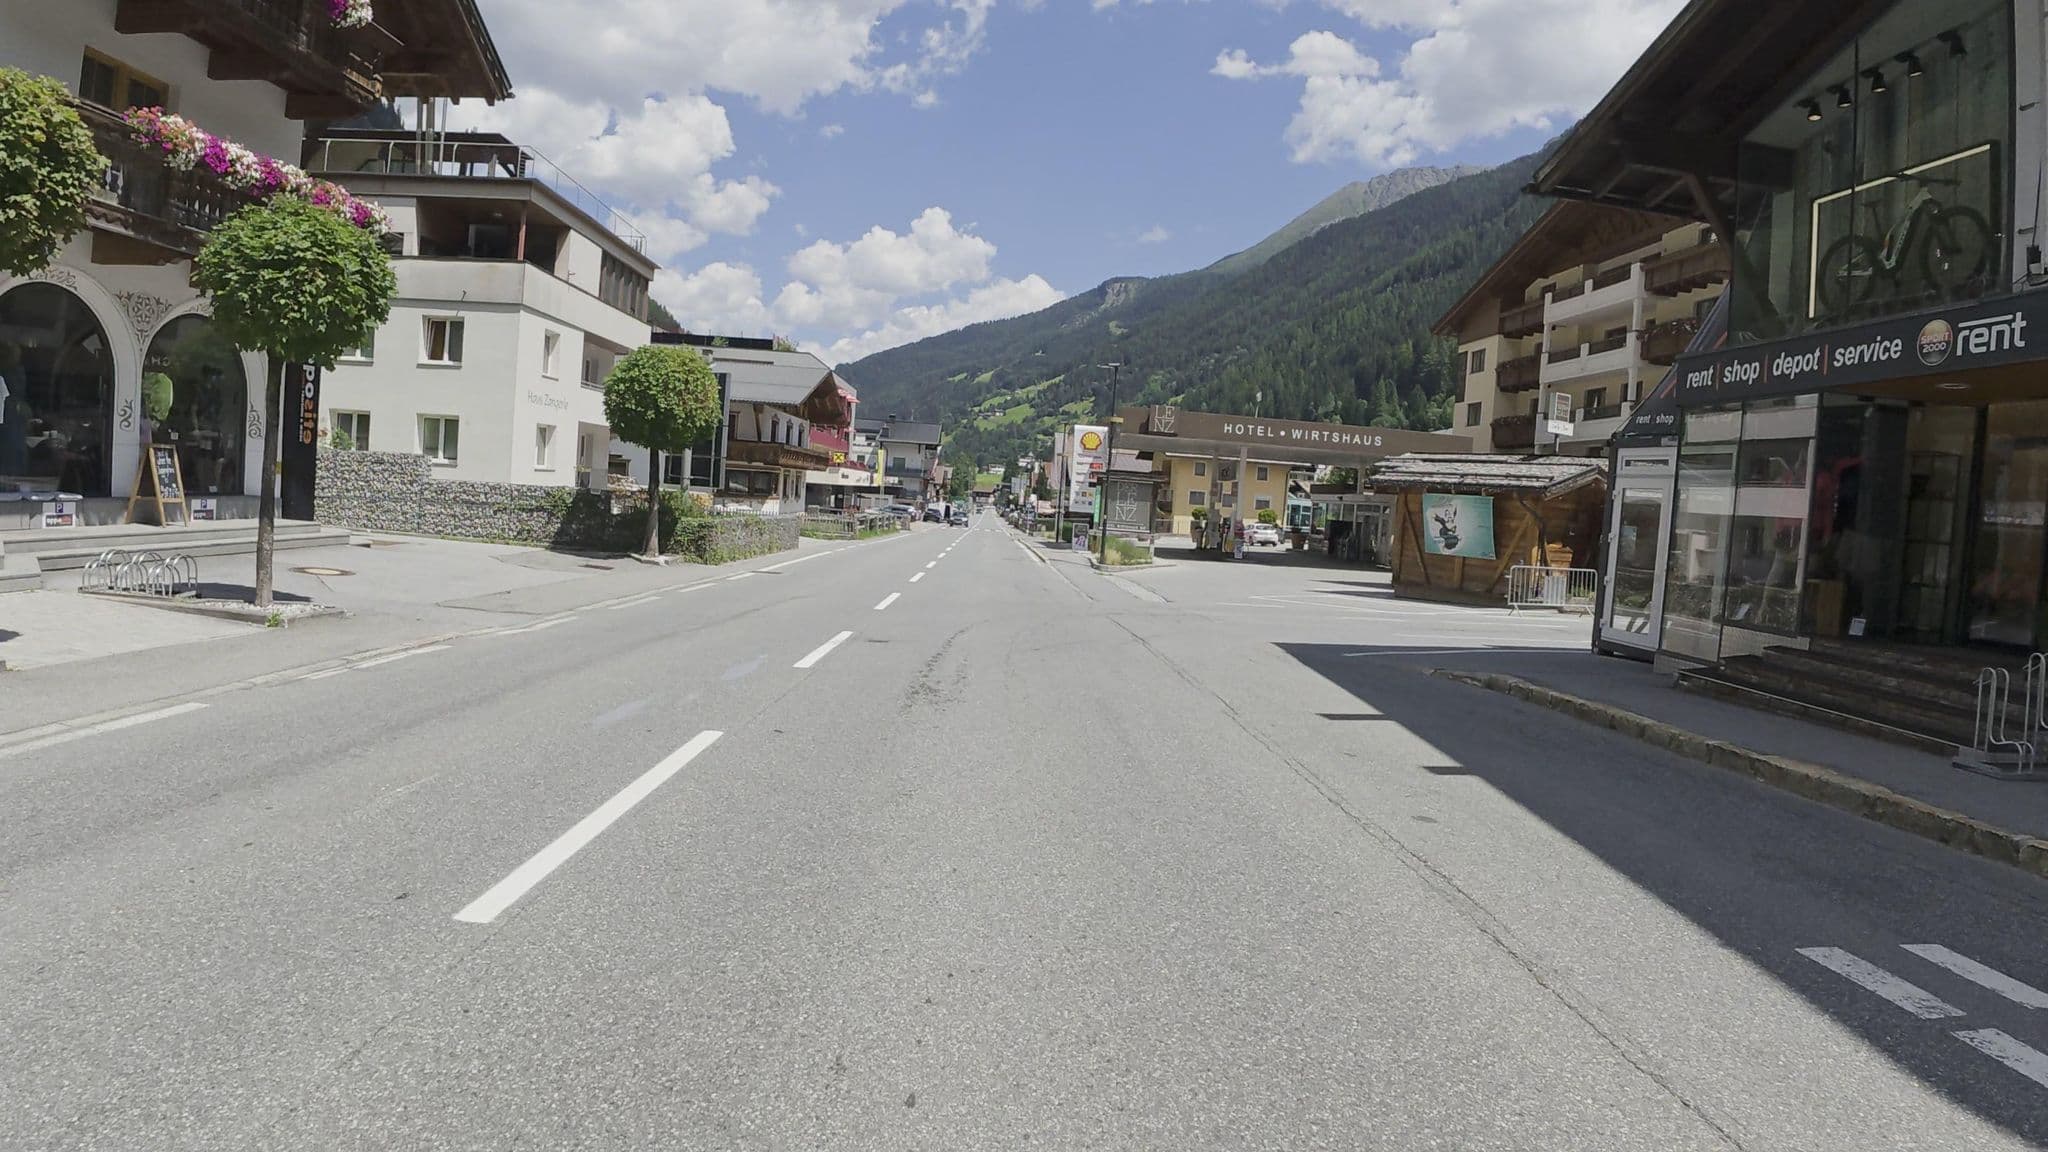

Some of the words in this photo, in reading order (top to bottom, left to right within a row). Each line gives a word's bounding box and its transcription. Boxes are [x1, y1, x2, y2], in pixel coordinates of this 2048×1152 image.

[1920, 331, 1950, 345] SPORT
[1956, 312, 2027, 356] rent
[1922, 342, 1947, 353] 2000
[1686, 365, 1713, 389] rent
[1723, 360, 1760, 385] shop
[1772, 347, 1820, 380] depot
[1833, 336, 1903, 368] service
[1636, 414, 1650, 424] rent
[1656, 413, 1674, 425] shop
[1224, 423, 1274, 437] HOTEL
[1291, 429, 1382, 446] WIRTSHAUS
